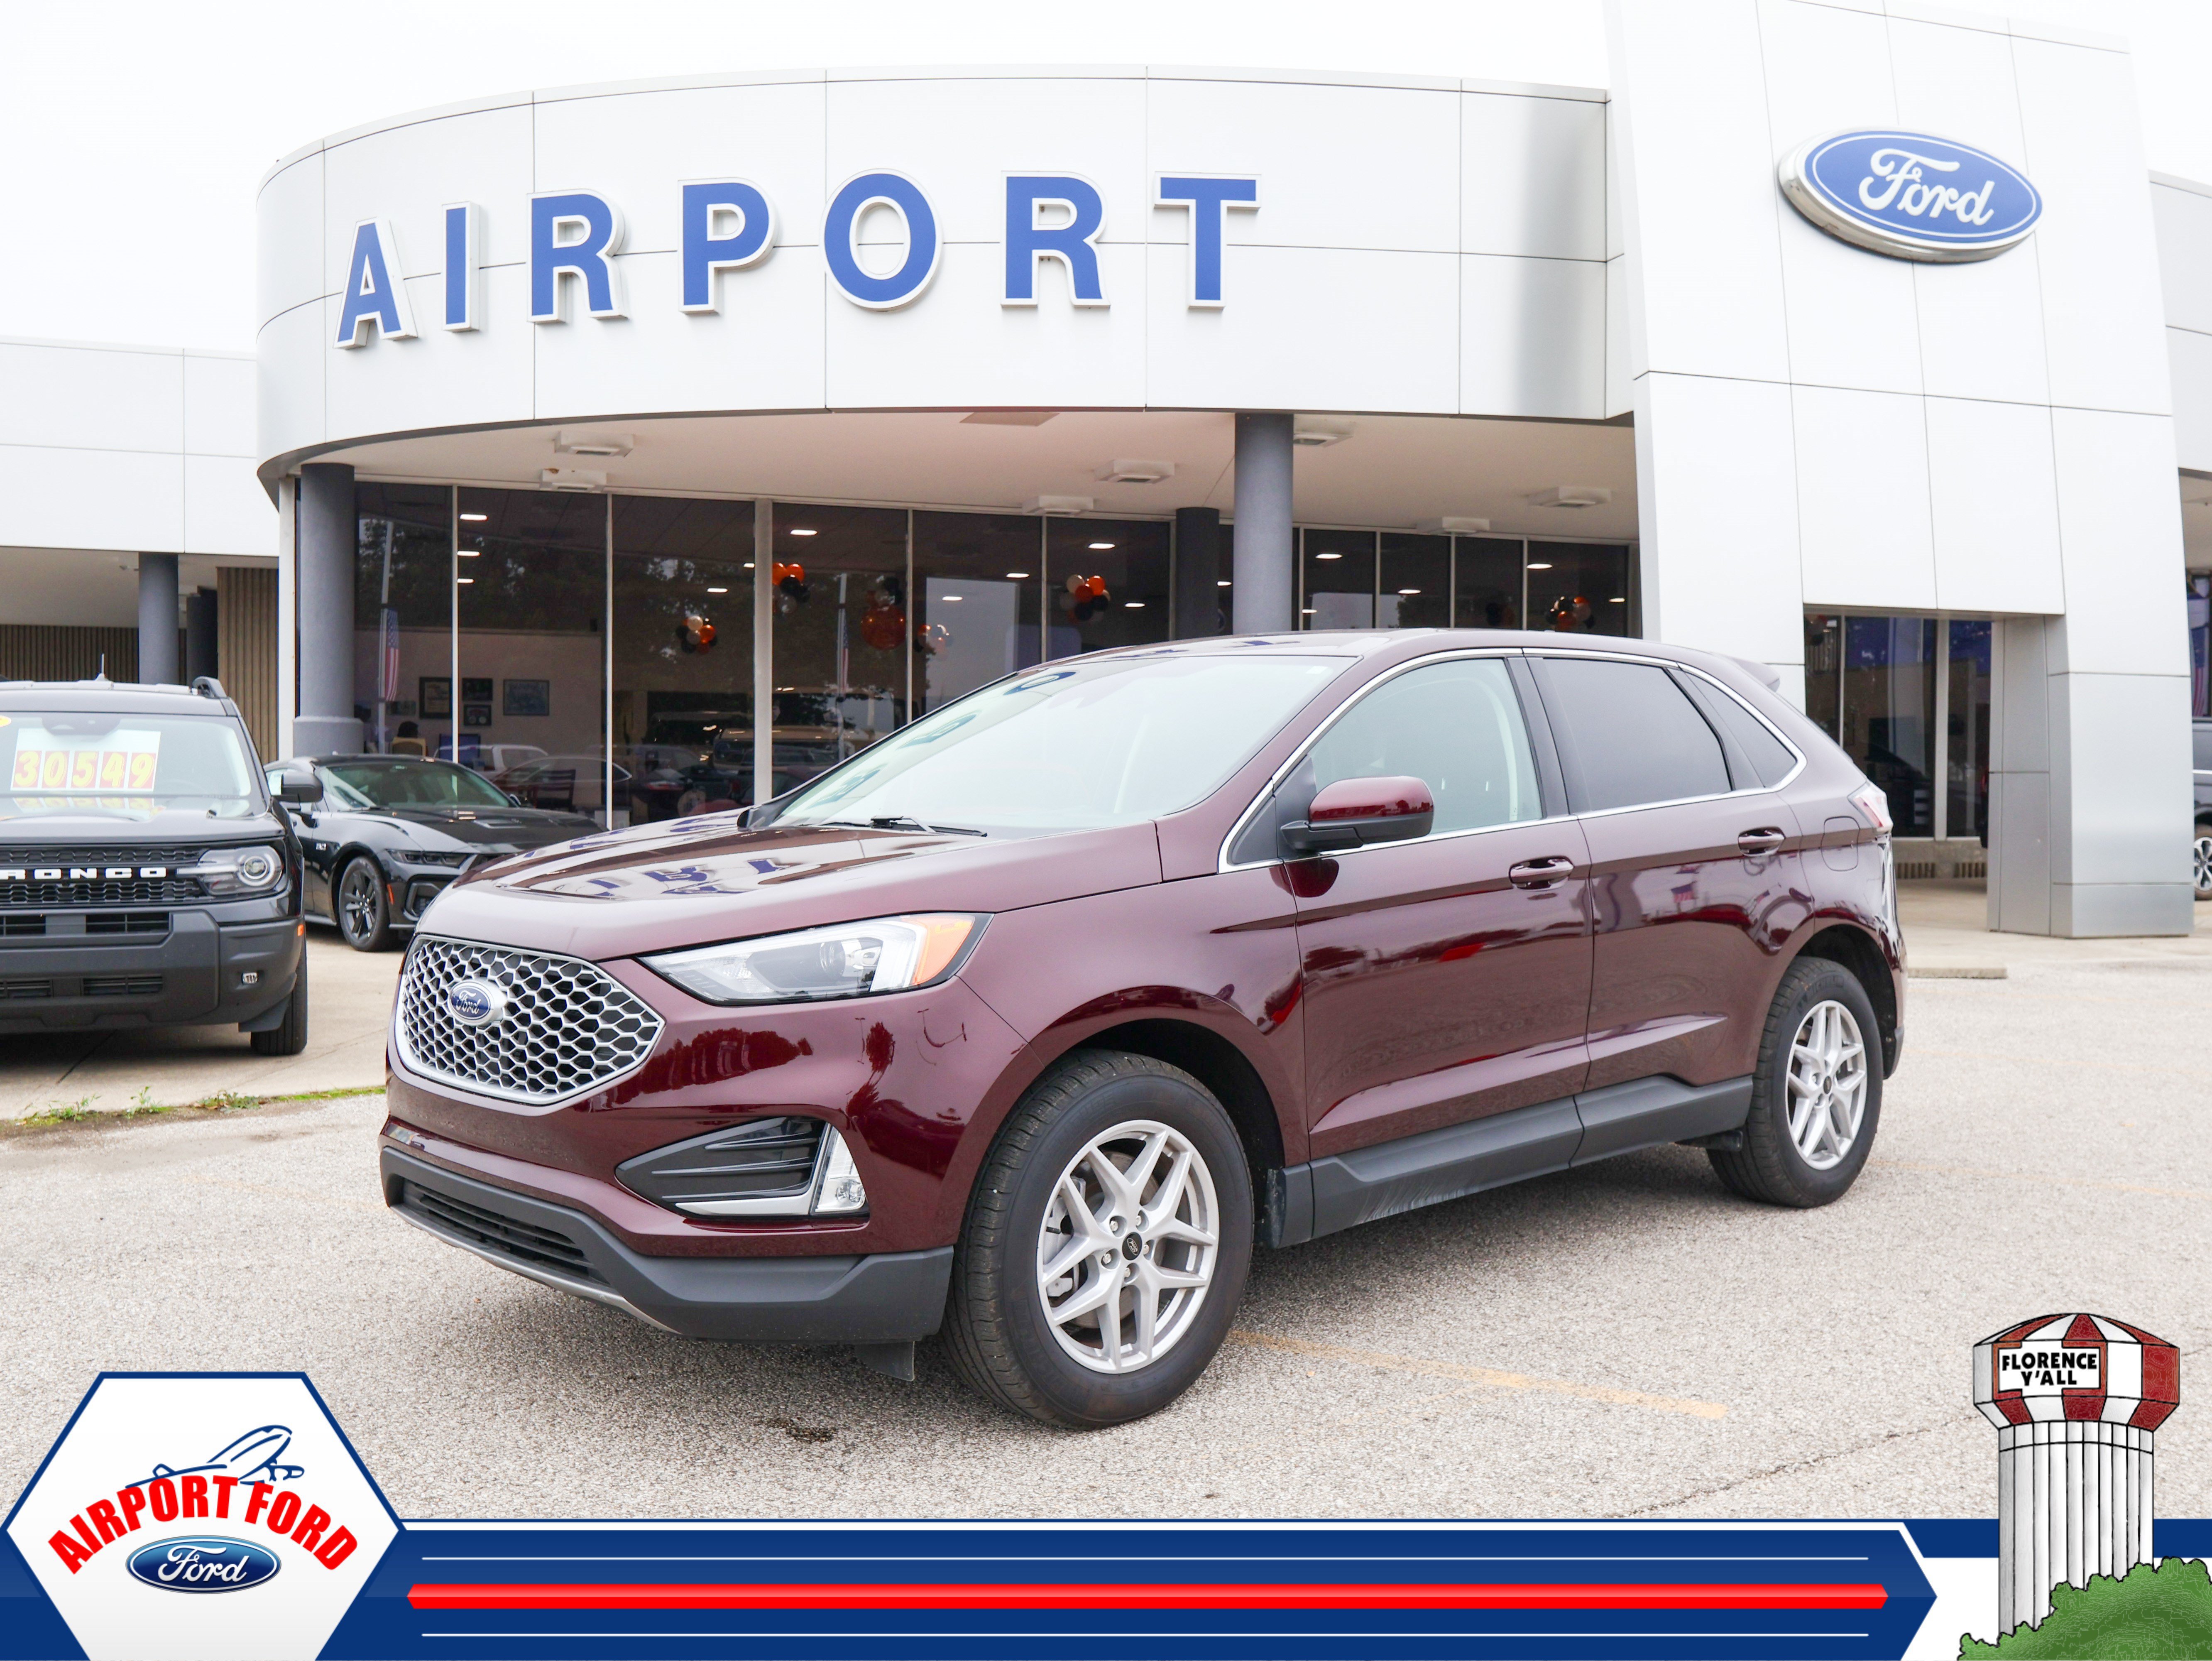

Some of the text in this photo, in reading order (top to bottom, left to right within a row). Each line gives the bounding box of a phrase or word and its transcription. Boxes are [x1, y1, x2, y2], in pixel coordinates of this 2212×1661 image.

[1858, 147, 1995, 225] Ford
[335, 171, 1260, 347] AIRPORT
[15, 751, 154, 788] 30549
[456, 990, 482, 1014] Ford
